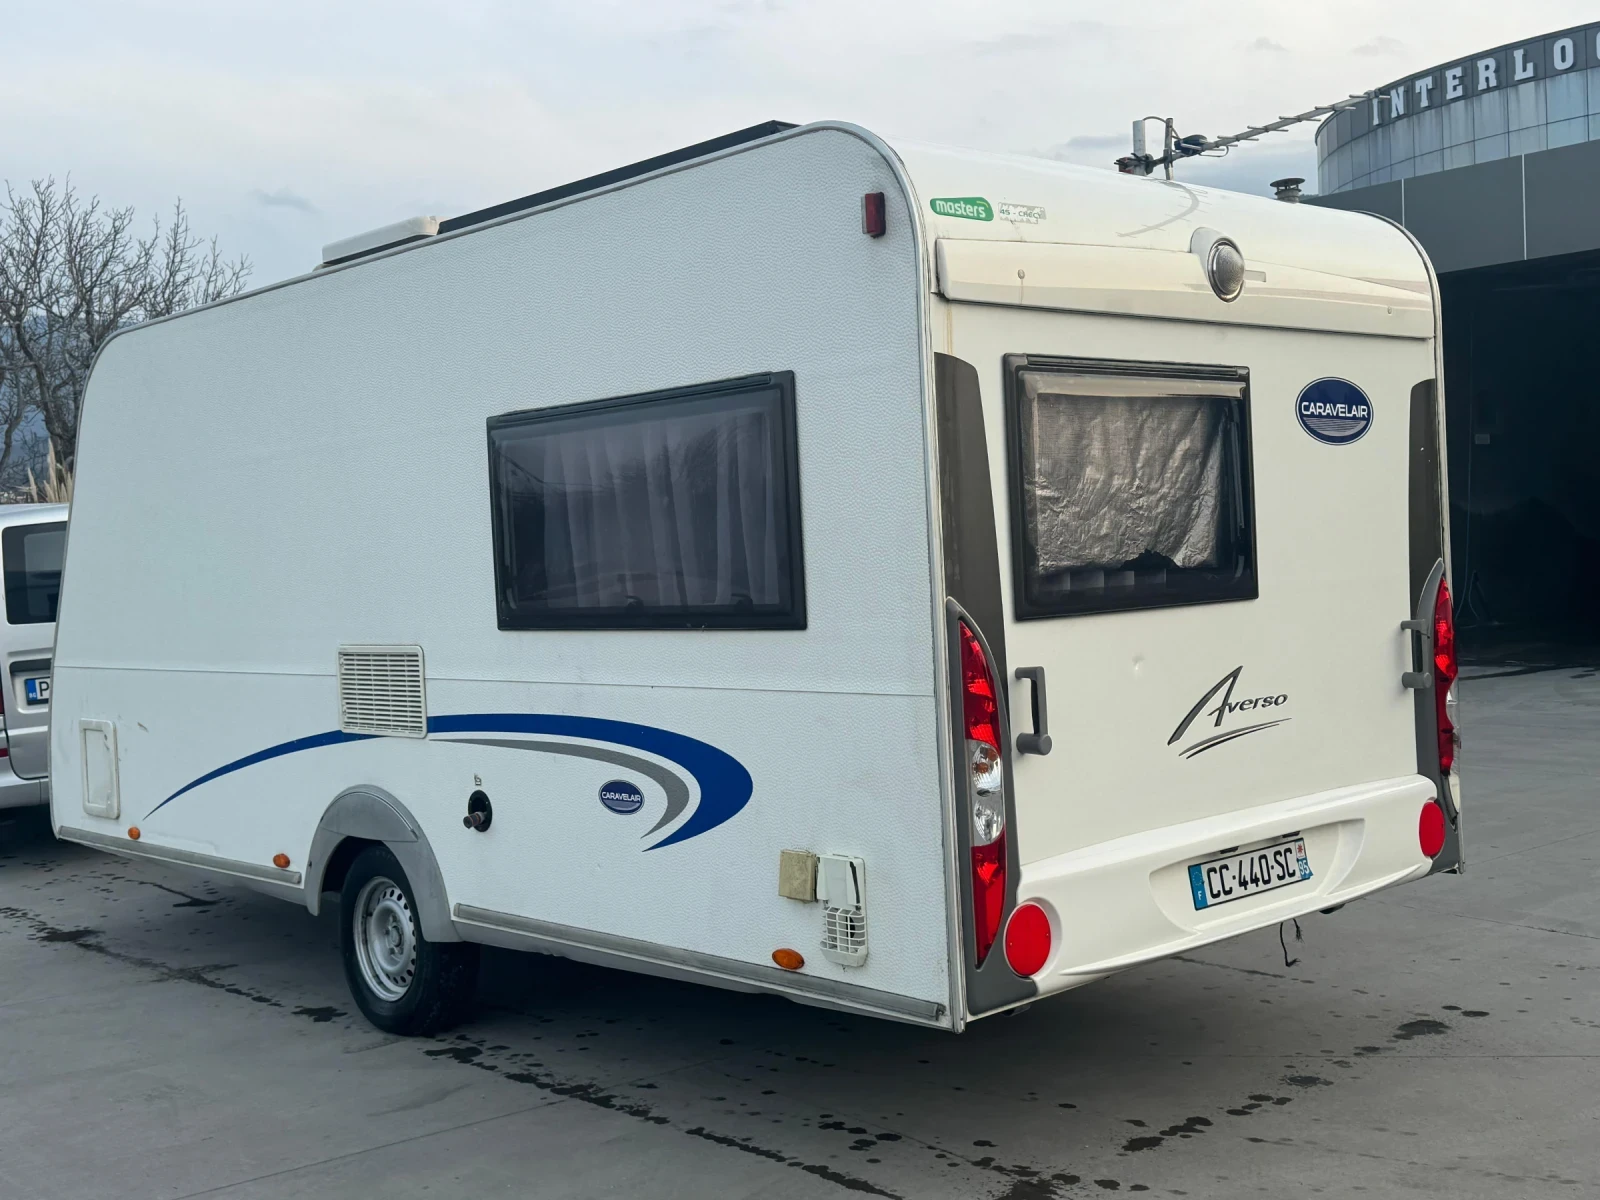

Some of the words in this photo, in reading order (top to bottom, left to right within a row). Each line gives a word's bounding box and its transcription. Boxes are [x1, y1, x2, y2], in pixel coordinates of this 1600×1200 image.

[1371, 31, 1600, 126] INTERLO
[935, 200, 986, 218] masters
[1301, 401, 1368, 418] CARAVELAIR
[601, 791, 641, 802] CARAVELAIR
[1298, 859, 1310, 876] 95
[1197, 890, 1203, 901] F
